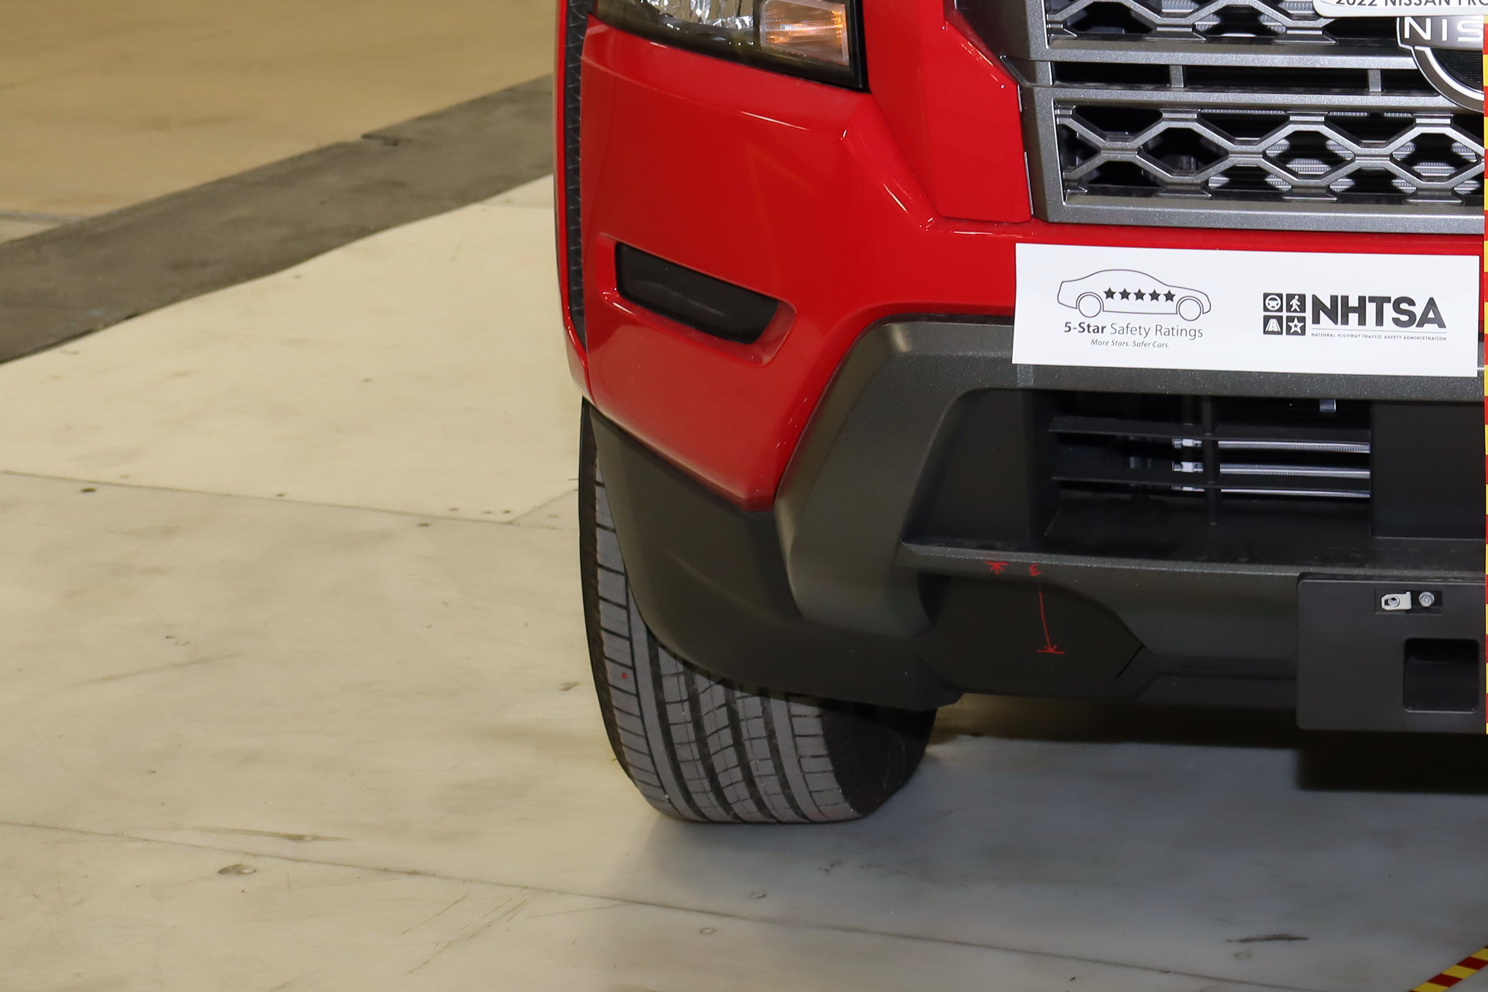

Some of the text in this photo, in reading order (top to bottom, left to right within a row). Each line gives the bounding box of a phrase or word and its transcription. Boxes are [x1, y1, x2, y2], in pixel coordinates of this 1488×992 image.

[1312, 294, 1446, 328] NHTSA
[1063, 321, 1204, 341] 5-Star Safety Ratings
[1090, 338, 1170, 349] More Stars. Safer Cars.
